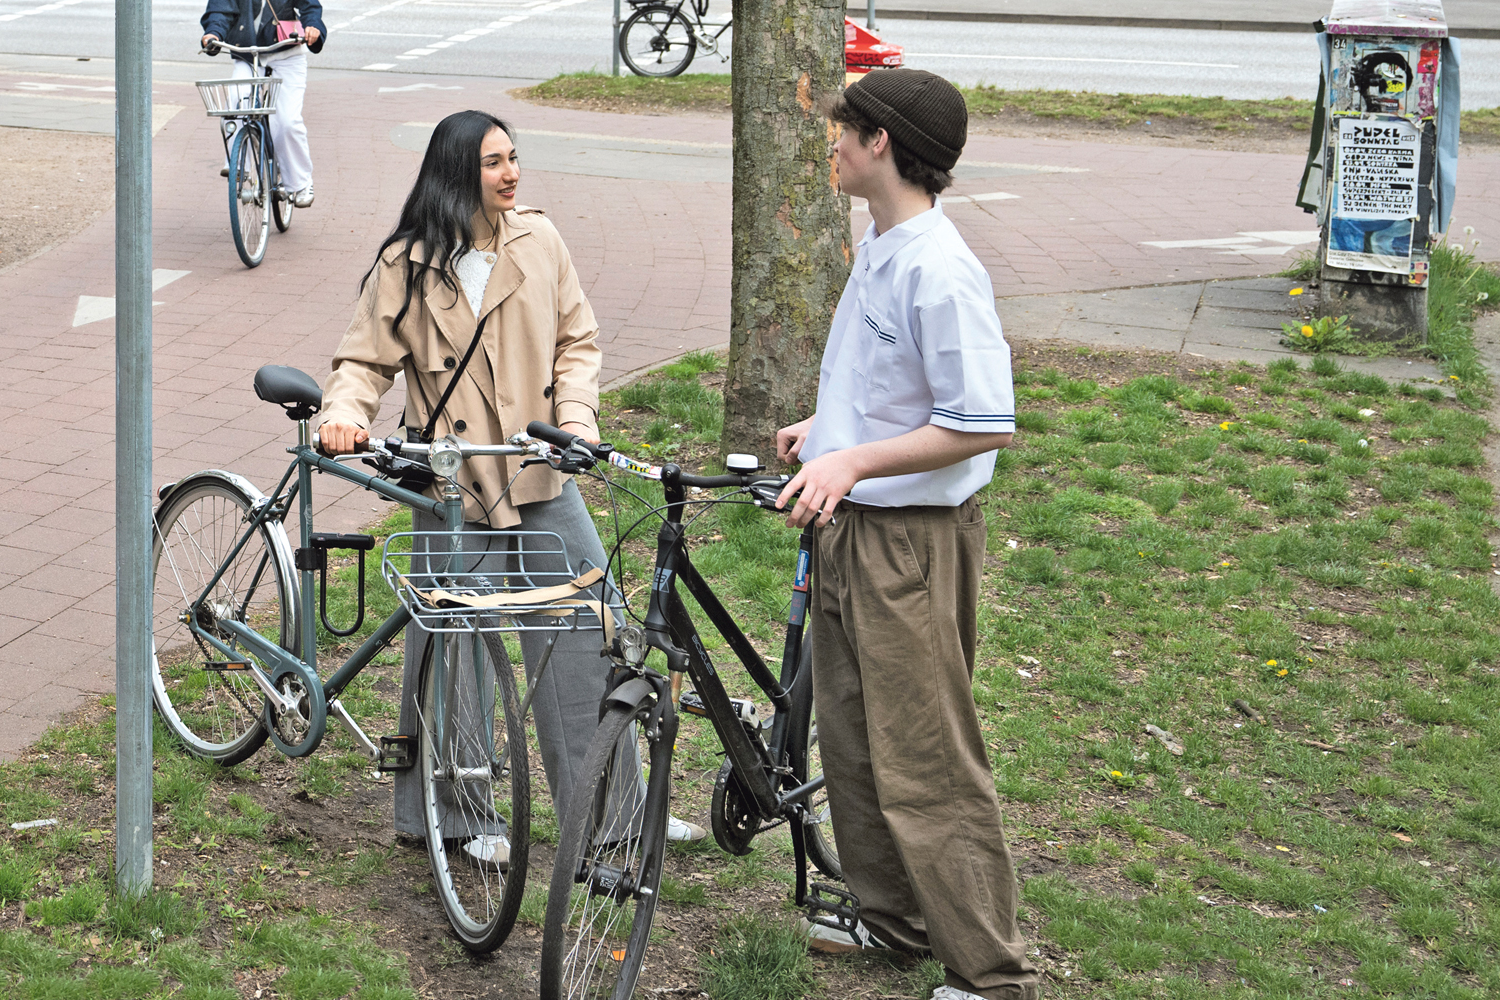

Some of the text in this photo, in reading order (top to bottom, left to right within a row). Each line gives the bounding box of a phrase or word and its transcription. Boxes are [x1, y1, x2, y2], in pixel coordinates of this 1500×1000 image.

[1334, 39, 1346, 49] 34
[1354, 126, 1400, 137] PUDEL
[691, 634, 715, 676] BICYCLES
